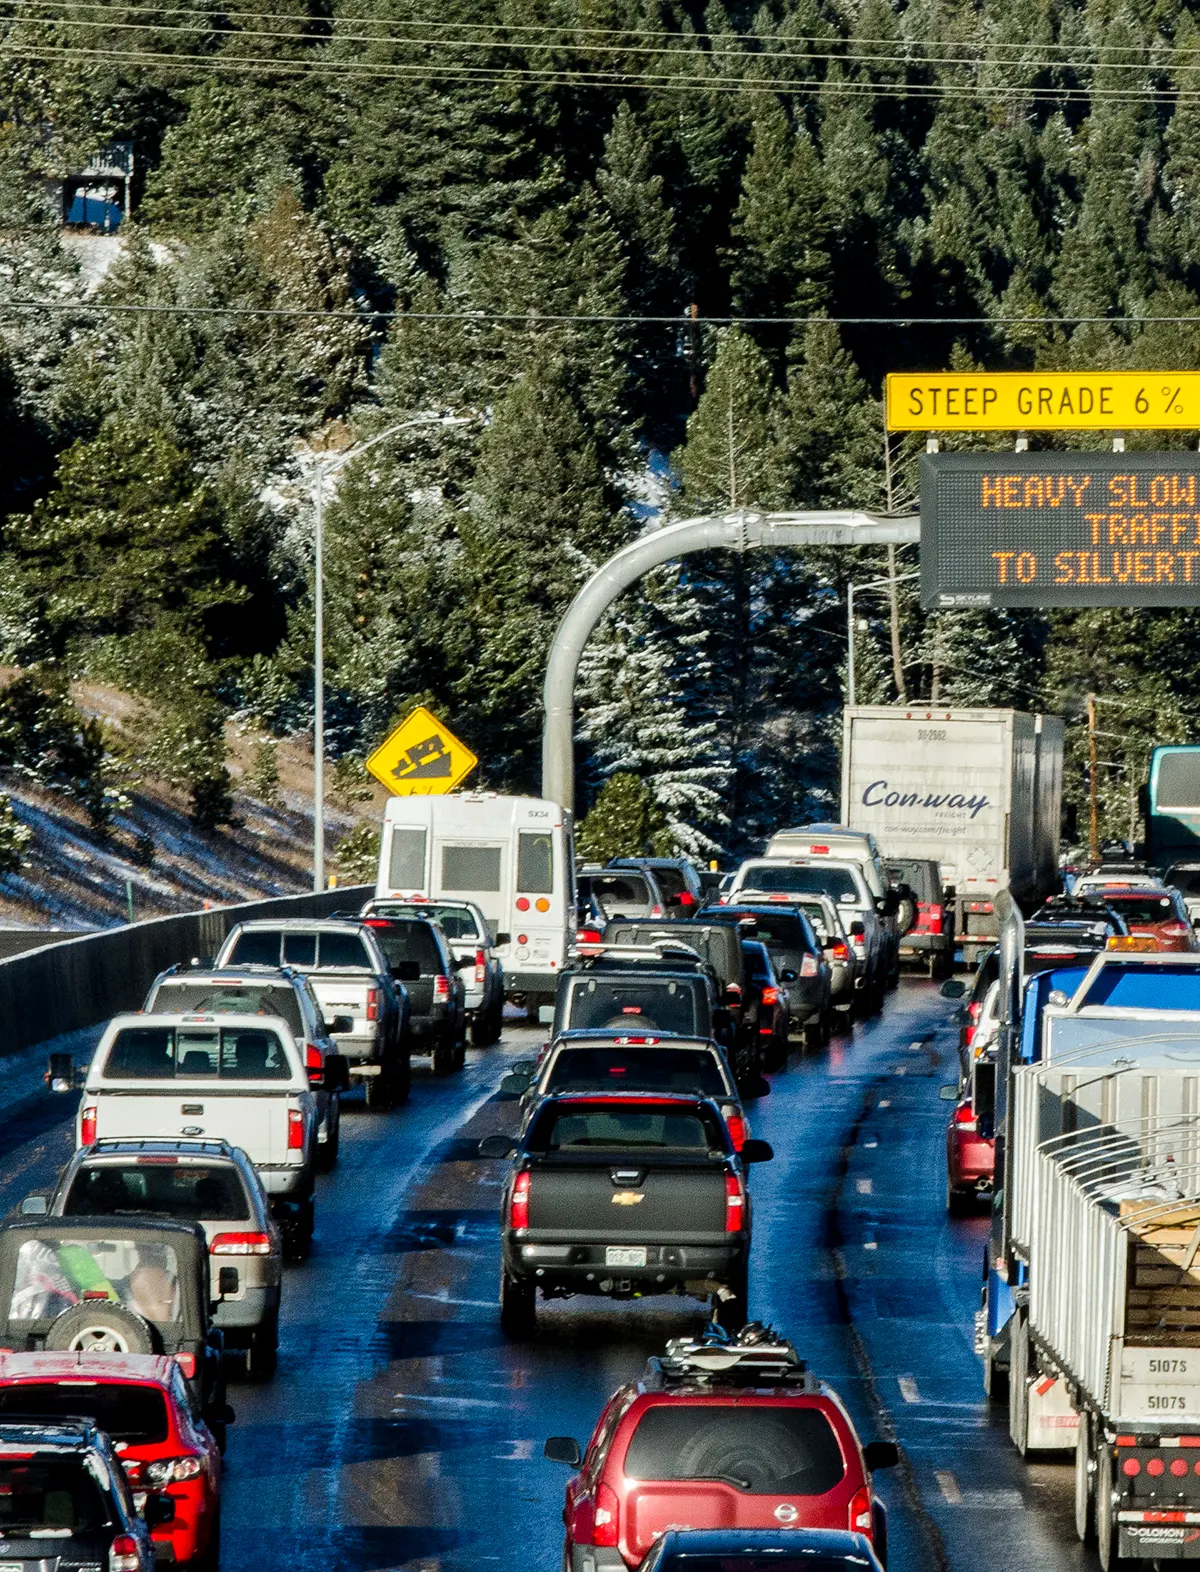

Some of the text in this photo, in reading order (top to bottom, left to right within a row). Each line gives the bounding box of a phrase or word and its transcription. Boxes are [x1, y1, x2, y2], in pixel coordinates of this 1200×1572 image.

[908, 387, 998, 416] STEEP
[1017, 386, 1114, 415] GRADE
[981, 475, 1090, 508] HEAVY
[1107, 474, 1196, 507] SLOW
[991, 551, 1037, 583] TO
[862, 780, 990, 819] Con-way
[934, 811, 967, 819] FREIGHT
[1149, 1359, 1187, 1373] 5107S
[1148, 1396, 1186, 1409] 5107S
[1127, 1526, 1185, 1538] SOLOMON
